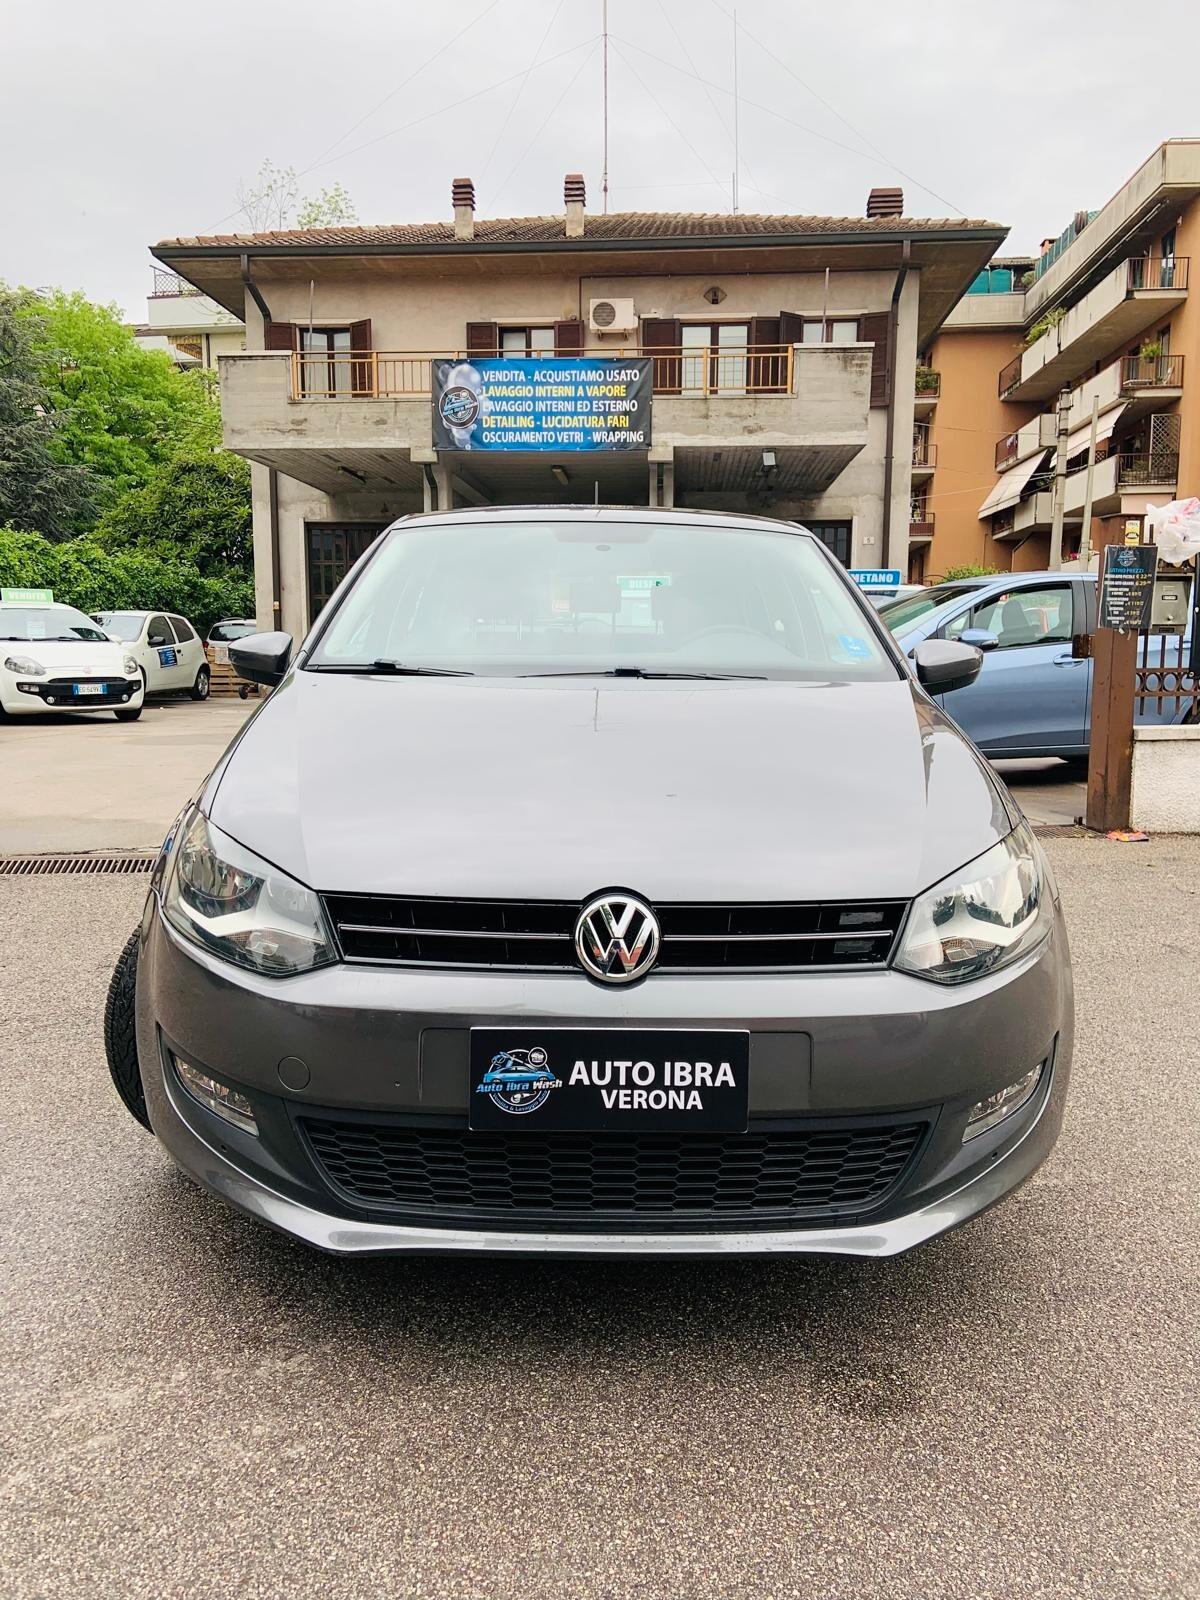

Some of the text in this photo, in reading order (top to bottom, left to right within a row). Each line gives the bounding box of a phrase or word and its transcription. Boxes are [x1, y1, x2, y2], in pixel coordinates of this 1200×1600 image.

[483, 370, 525, 382] VENDITA
[533, 370, 604, 383] ACQUISTIAMO
[606, 369, 640, 381] USATO
[482, 384, 627, 397] LAVAGGIO INTERNI A VAPORE
[482, 400, 534, 412] LAVAGGIO
[535, 400, 575, 412] INTERNI
[577, 400, 590, 412] ED
[592, 399, 638, 412] ESTERNO
[482, 415, 535, 428] DETAILING
[542, 415, 605, 428] LUCIDATURA
[607, 415, 629, 428] FARI
[482, 431, 555, 443] OSCURAMENTO
[556, 431, 584, 443] VETRI
[592, 430, 644, 443] WRAPPING
[568, 1060, 737, 1087] AUTO IBRA
[476, 1079, 563, 1093] Auto Ibra Wash
[600, 1089, 704, 1110] VERONA
